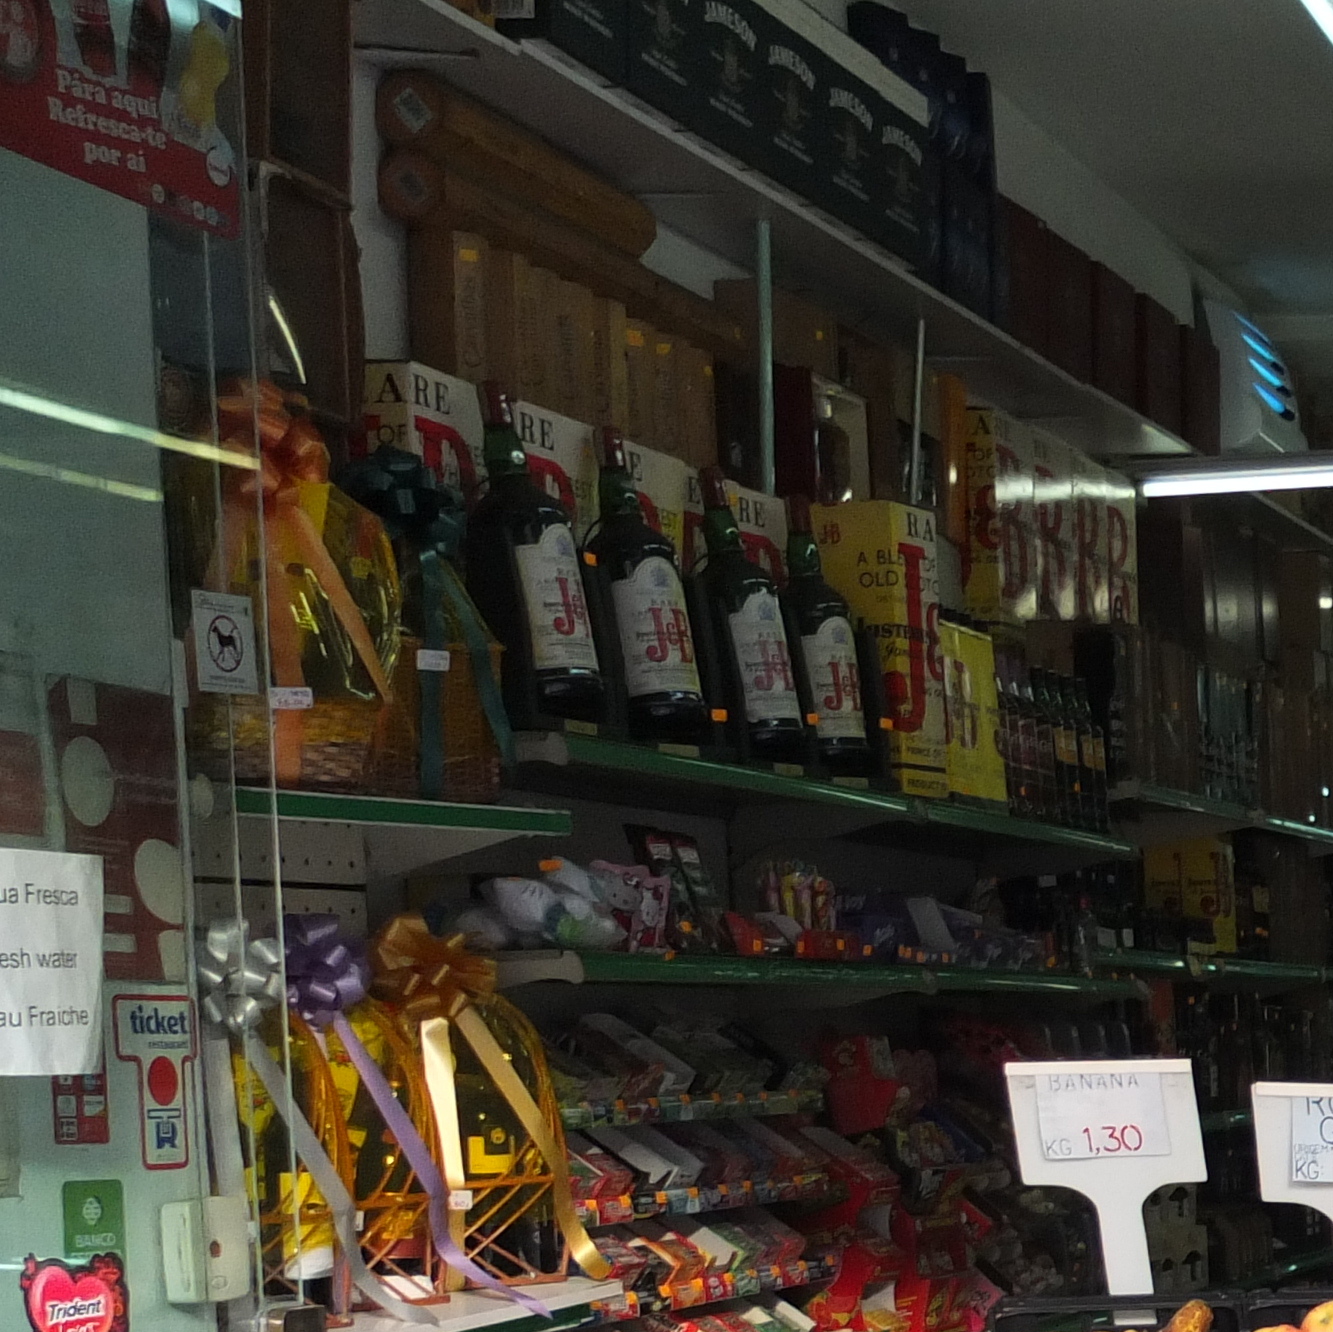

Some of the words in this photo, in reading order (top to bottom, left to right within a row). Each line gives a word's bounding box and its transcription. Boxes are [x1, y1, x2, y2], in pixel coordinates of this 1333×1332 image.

[25, 884, 79, 905] Fresca
[36, 953, 78, 970] water
[30, 1007, 89, 1027] Fraiche
[130, 1005, 187, 1036] ticket
[1048, 1073, 1139, 1091] BANANA
[1082, 1124, 1144, 1155] 1,30
[48, 1299, 101, 1322] Trident
